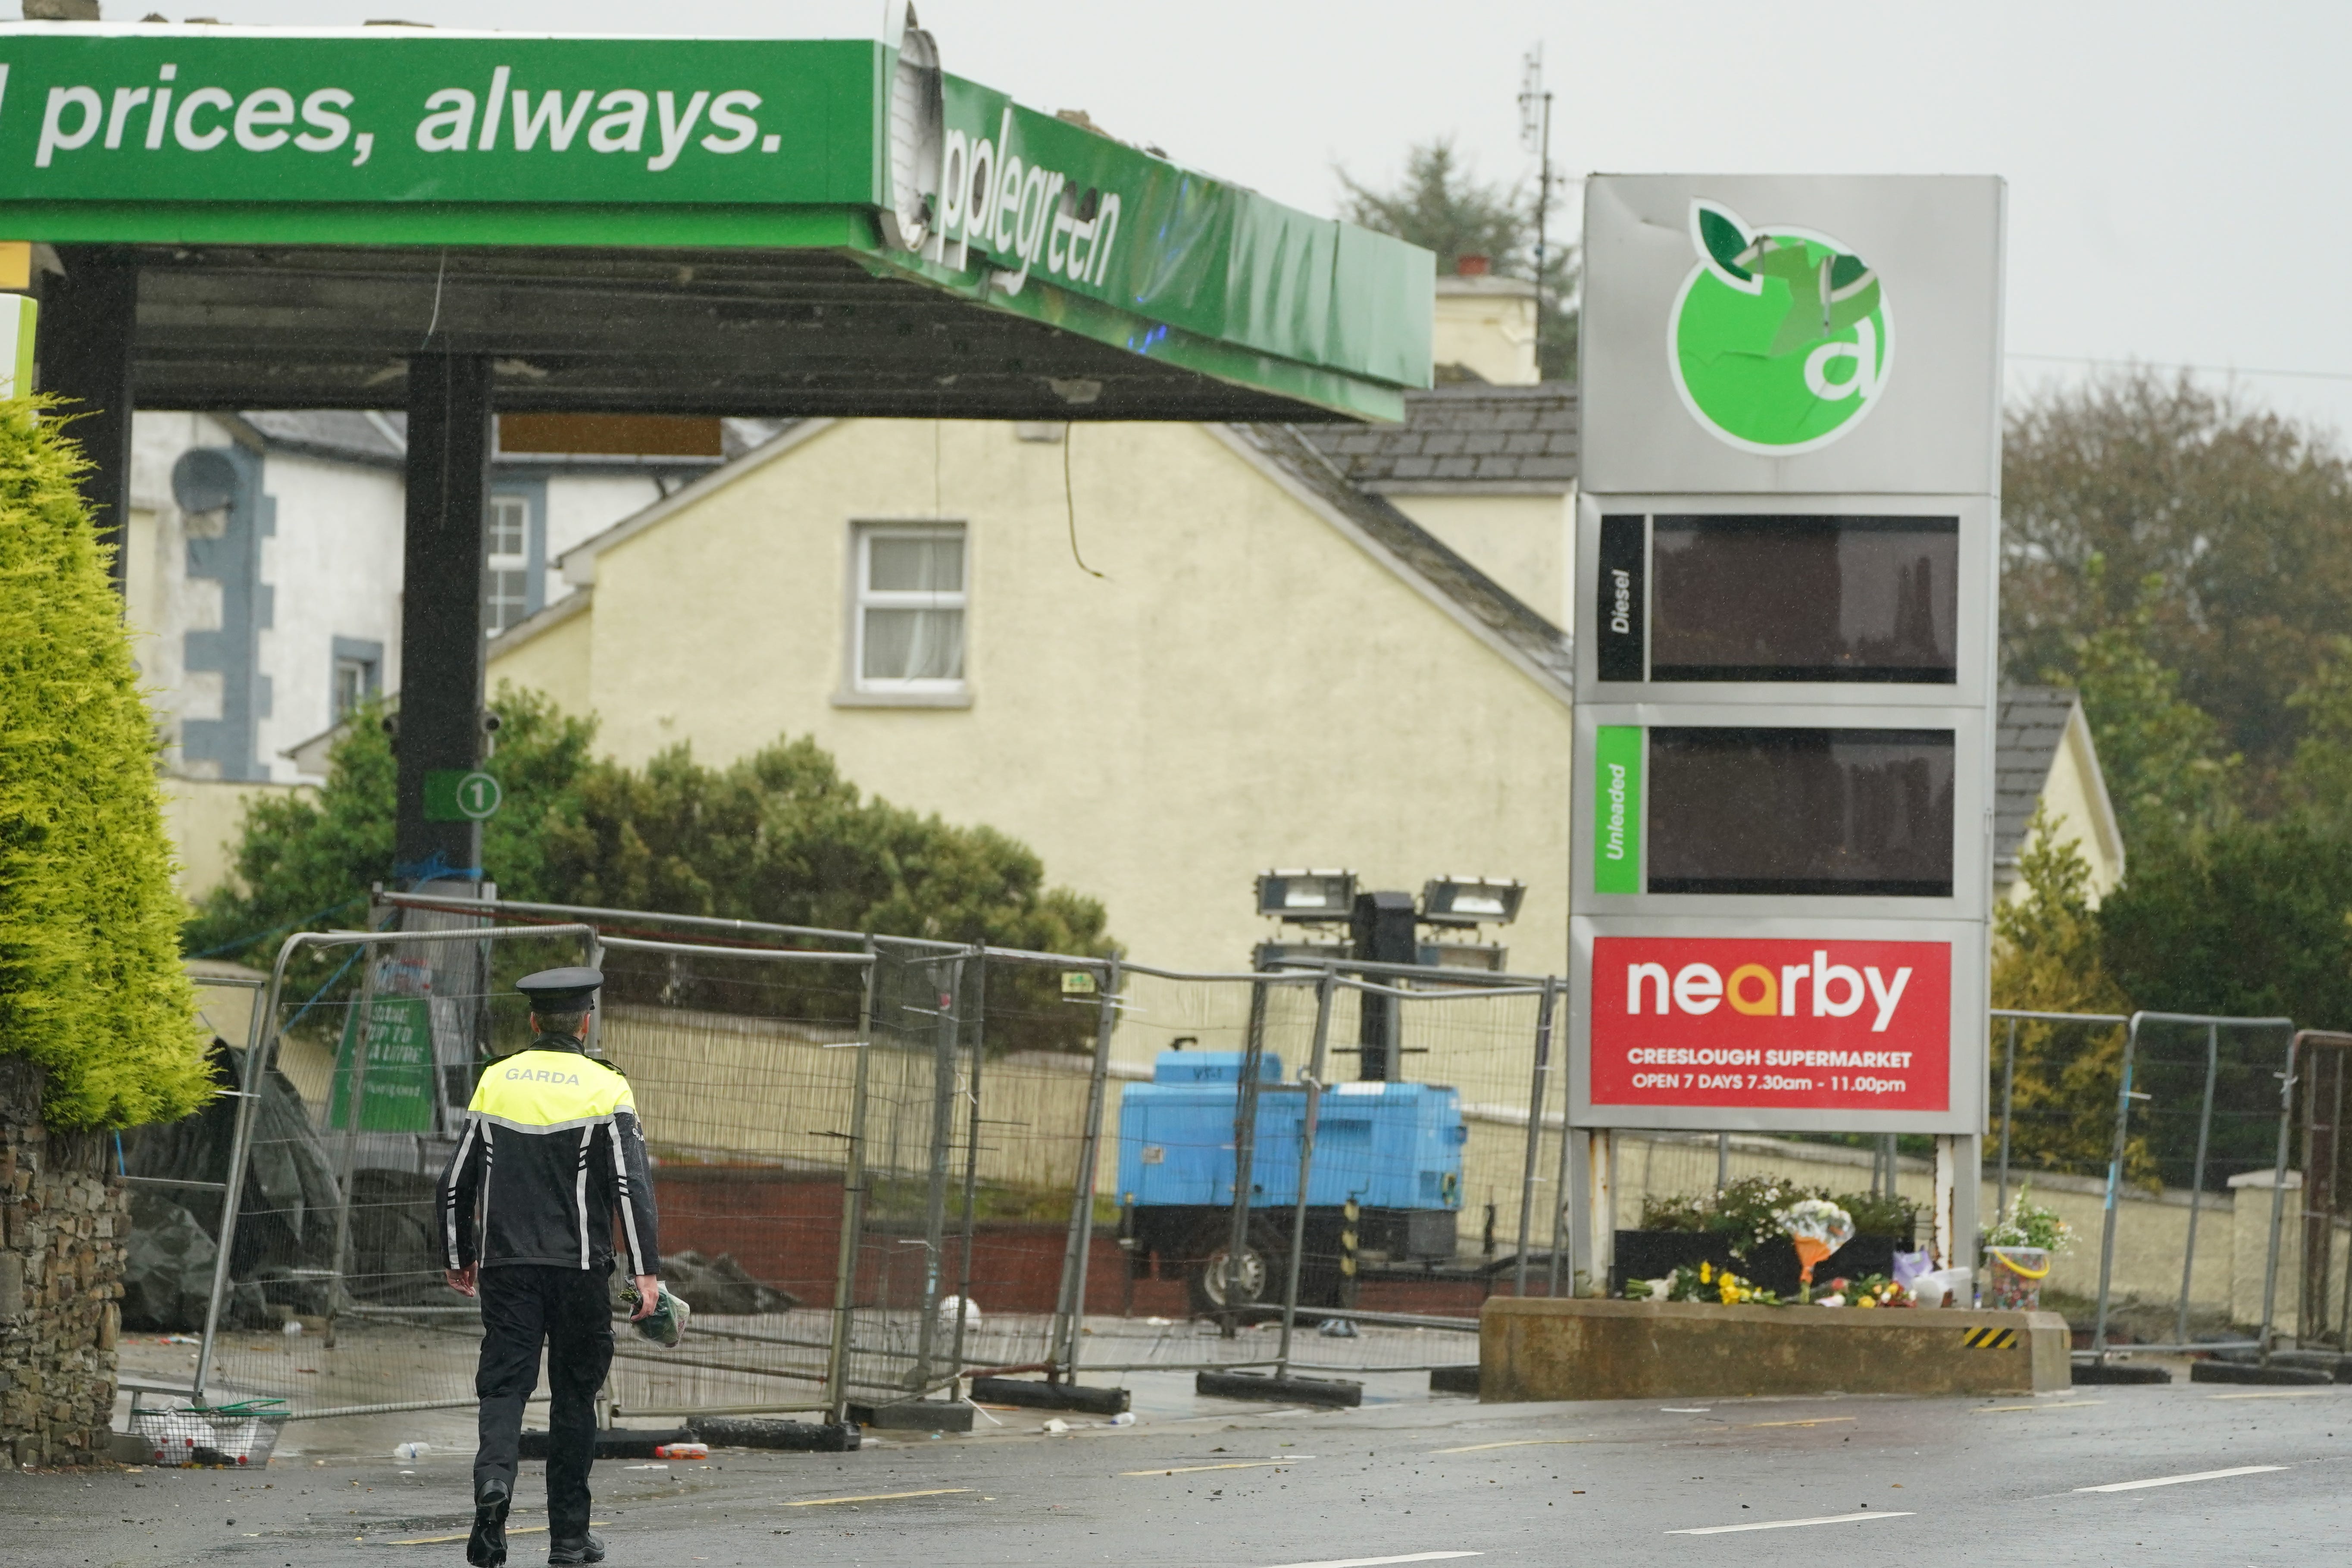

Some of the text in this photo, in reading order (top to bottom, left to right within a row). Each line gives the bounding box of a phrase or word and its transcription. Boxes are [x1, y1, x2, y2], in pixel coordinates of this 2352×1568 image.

[34, 63, 374, 167] prices,
[415, 65, 782, 172] always.
[1611, 569, 1630, 634] Diesel
[470, 782, 483, 809] 1
[1606, 764, 1626, 860] Unleaded
[1626, 949, 1913, 1033] nearby
[505, 1068, 580, 1086] GARDA
[1627, 1047, 1913, 1069] CREESLOUGH SUPERMARKET
[1632, 1072, 1680, 1089] OPEN
[1683, 1073, 1695, 1089] 7
[1698, 1073, 1743, 1090] DAYS
[1747, 1074, 1813, 1091] 7.30am
[1830, 1075, 1906, 1095] 11.00pm
